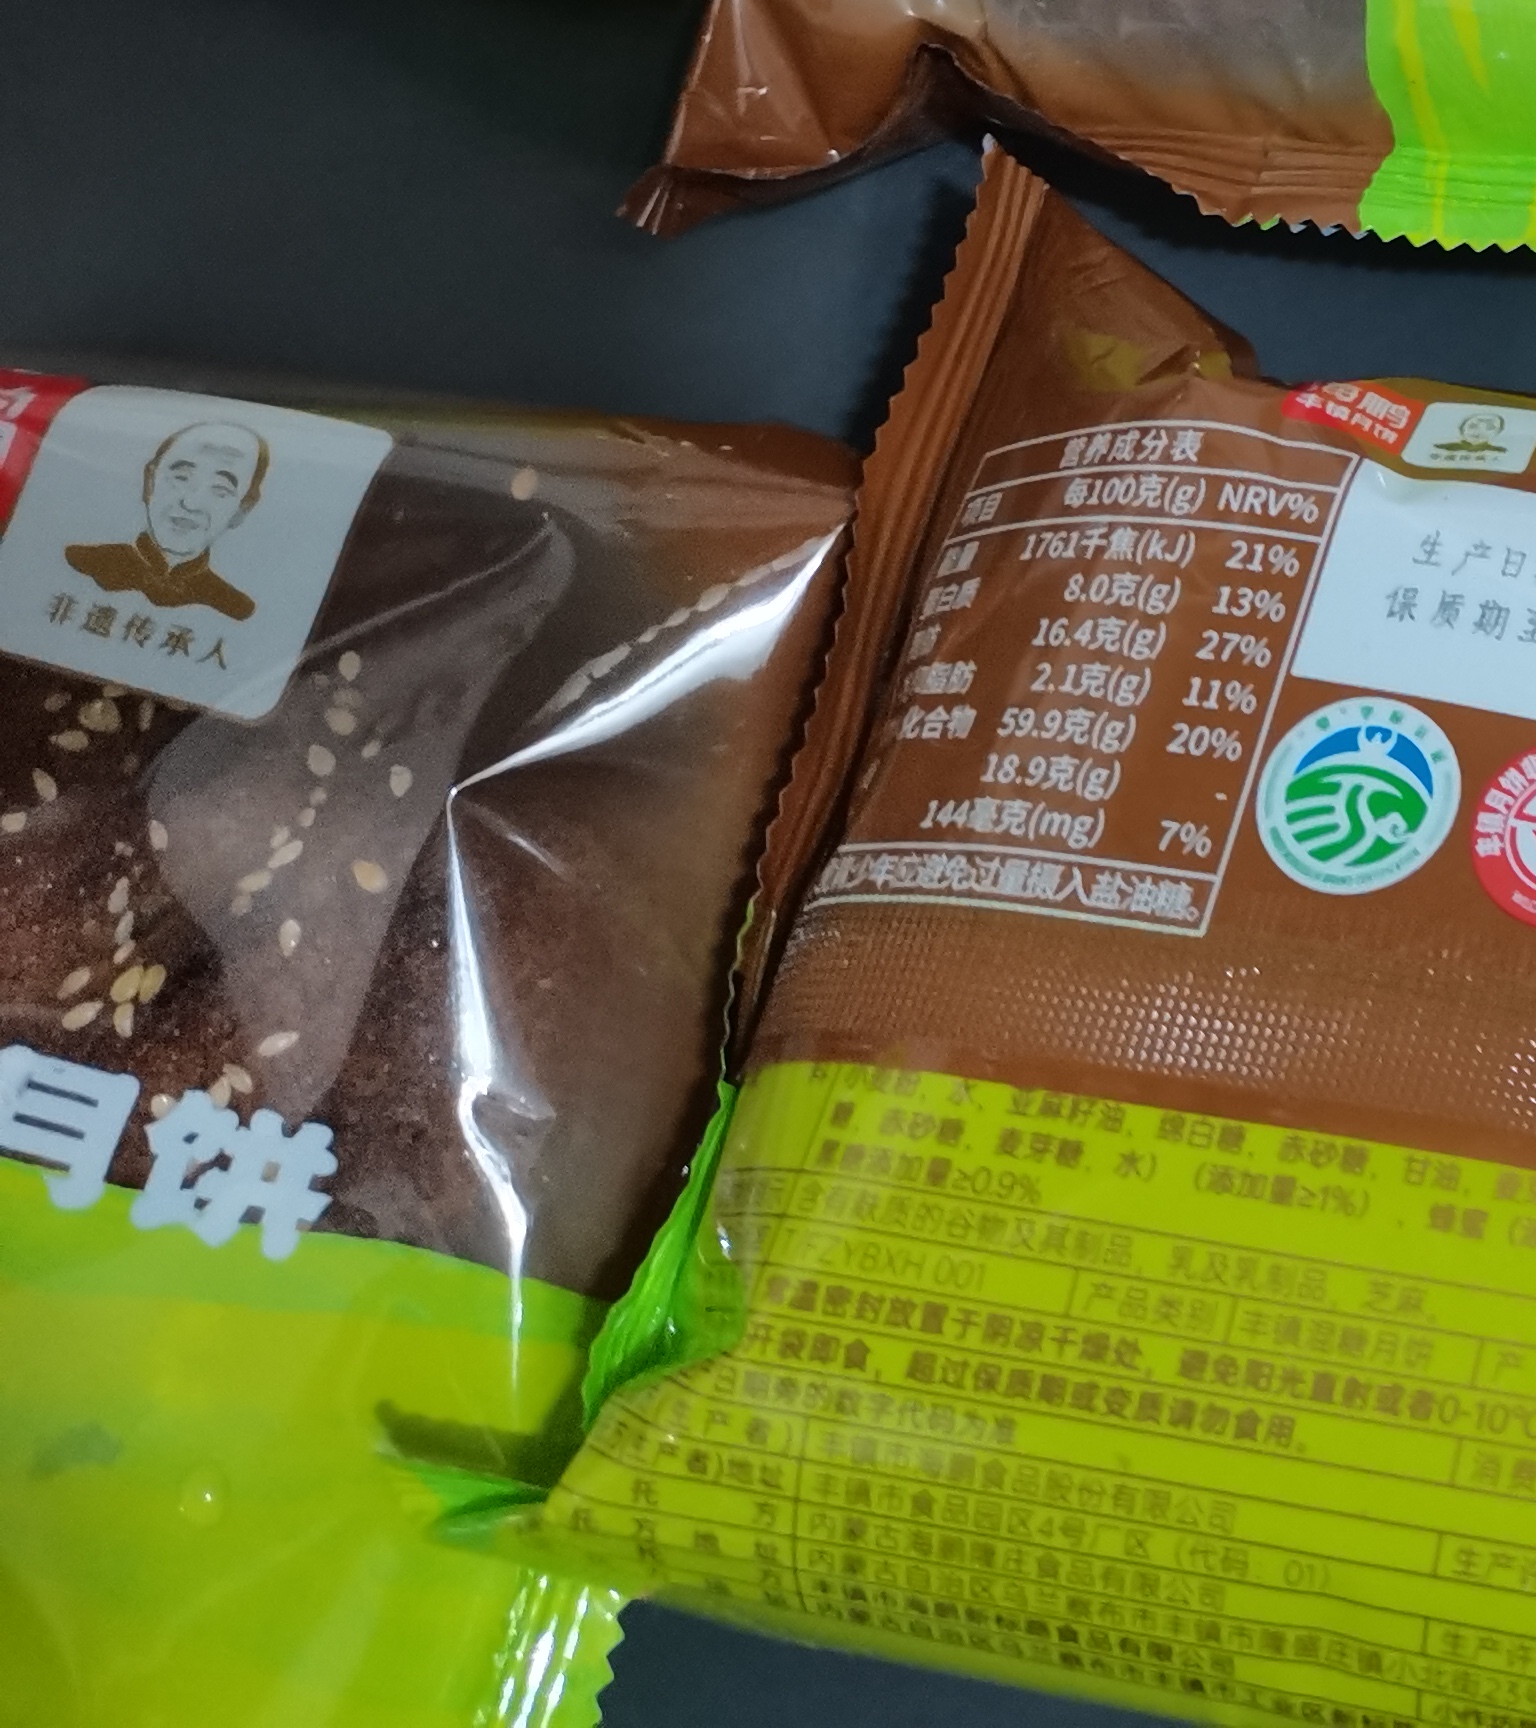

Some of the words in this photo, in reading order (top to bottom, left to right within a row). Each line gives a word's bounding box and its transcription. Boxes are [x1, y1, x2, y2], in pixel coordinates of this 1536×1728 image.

[1058, 428, 1205, 469] 营养成分表
[1063, 473, 1206, 514] 每100克(g)
[1216, 485, 1320, 523] NRV%
[1019, 521, 1197, 567] 1761千焦(kJ)
[1224, 539, 1300, 578] 21%
[1062, 573, 1182, 614] 8.0克(g)
[1210, 584, 1287, 623] 13%
[45, 588, 232, 674] 非遗传承人
[1030, 617, 1167, 661] 16.4克(g)
[1195, 630, 1273, 669] 27%
[1029, 661, 1153, 707] 2.1克(g)
[1181, 676, 1258, 715] 11%
[996, 707, 1138, 754] 59.9克(g)
[1165, 721, 1243, 760] 20%
[979, 753, 1123, 800] 18.9克(g)
[918, 796, 1107, 851] 144毫克(mg)
[1157, 819, 1212, 858] 7%
[934, 1255, 987, 1294] 001
[1083, 1280, 1219, 1338] 产品类别
